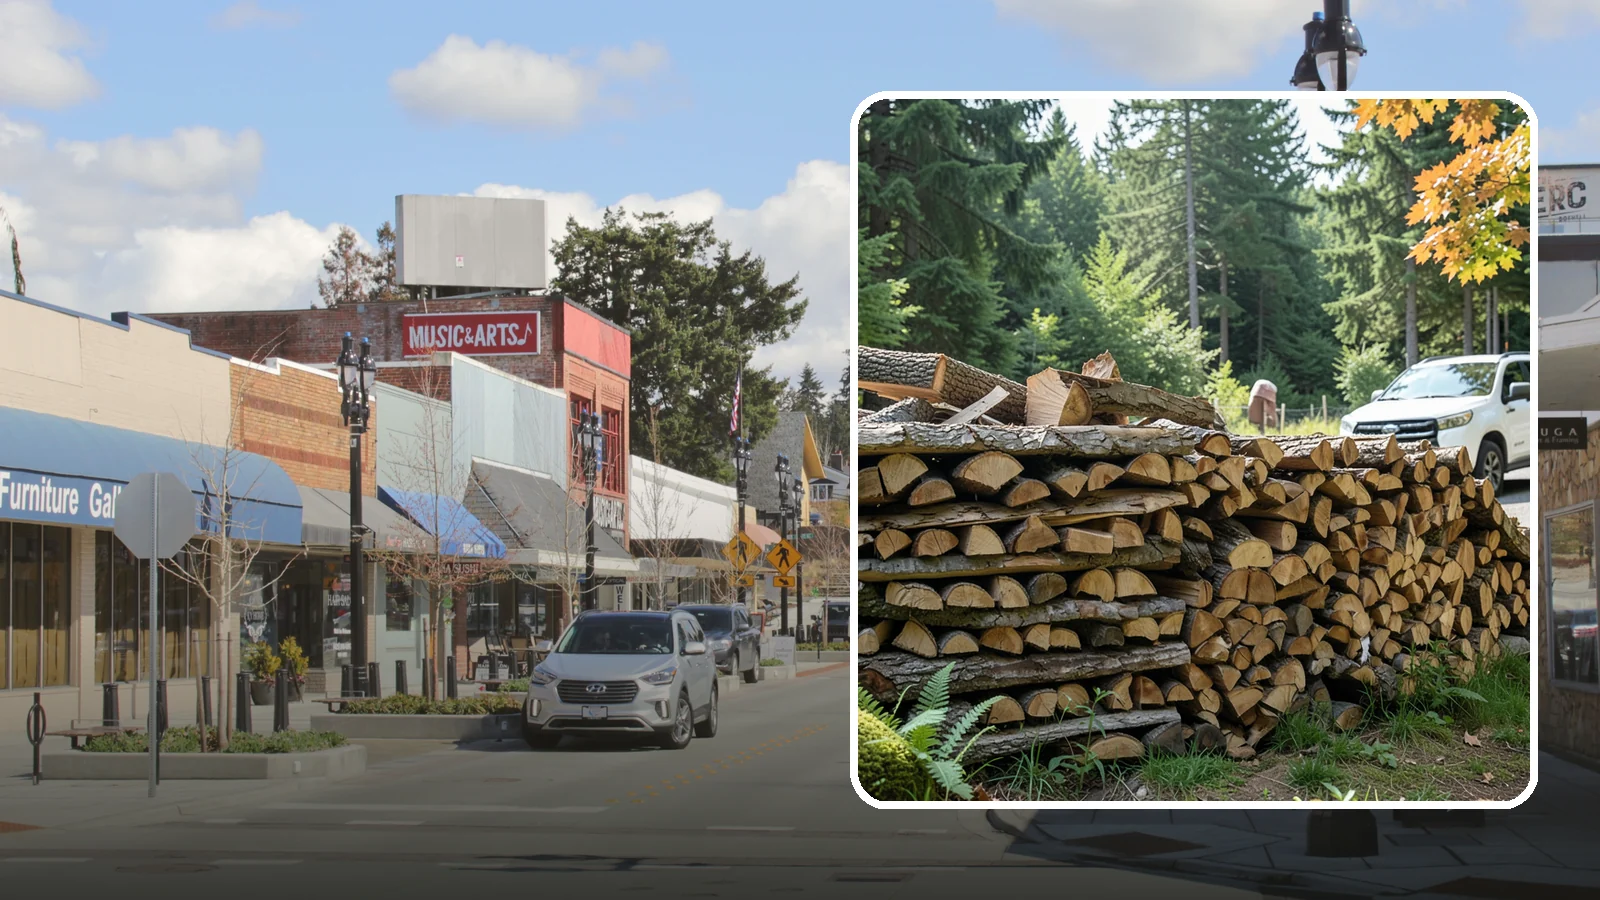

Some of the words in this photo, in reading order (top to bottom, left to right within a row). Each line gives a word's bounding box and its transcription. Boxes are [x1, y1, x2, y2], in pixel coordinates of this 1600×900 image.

[0, 471, 79, 515] Furniture
[89, 482, 121, 519] Gal
[453, 563, 479, 574] SUSHI
